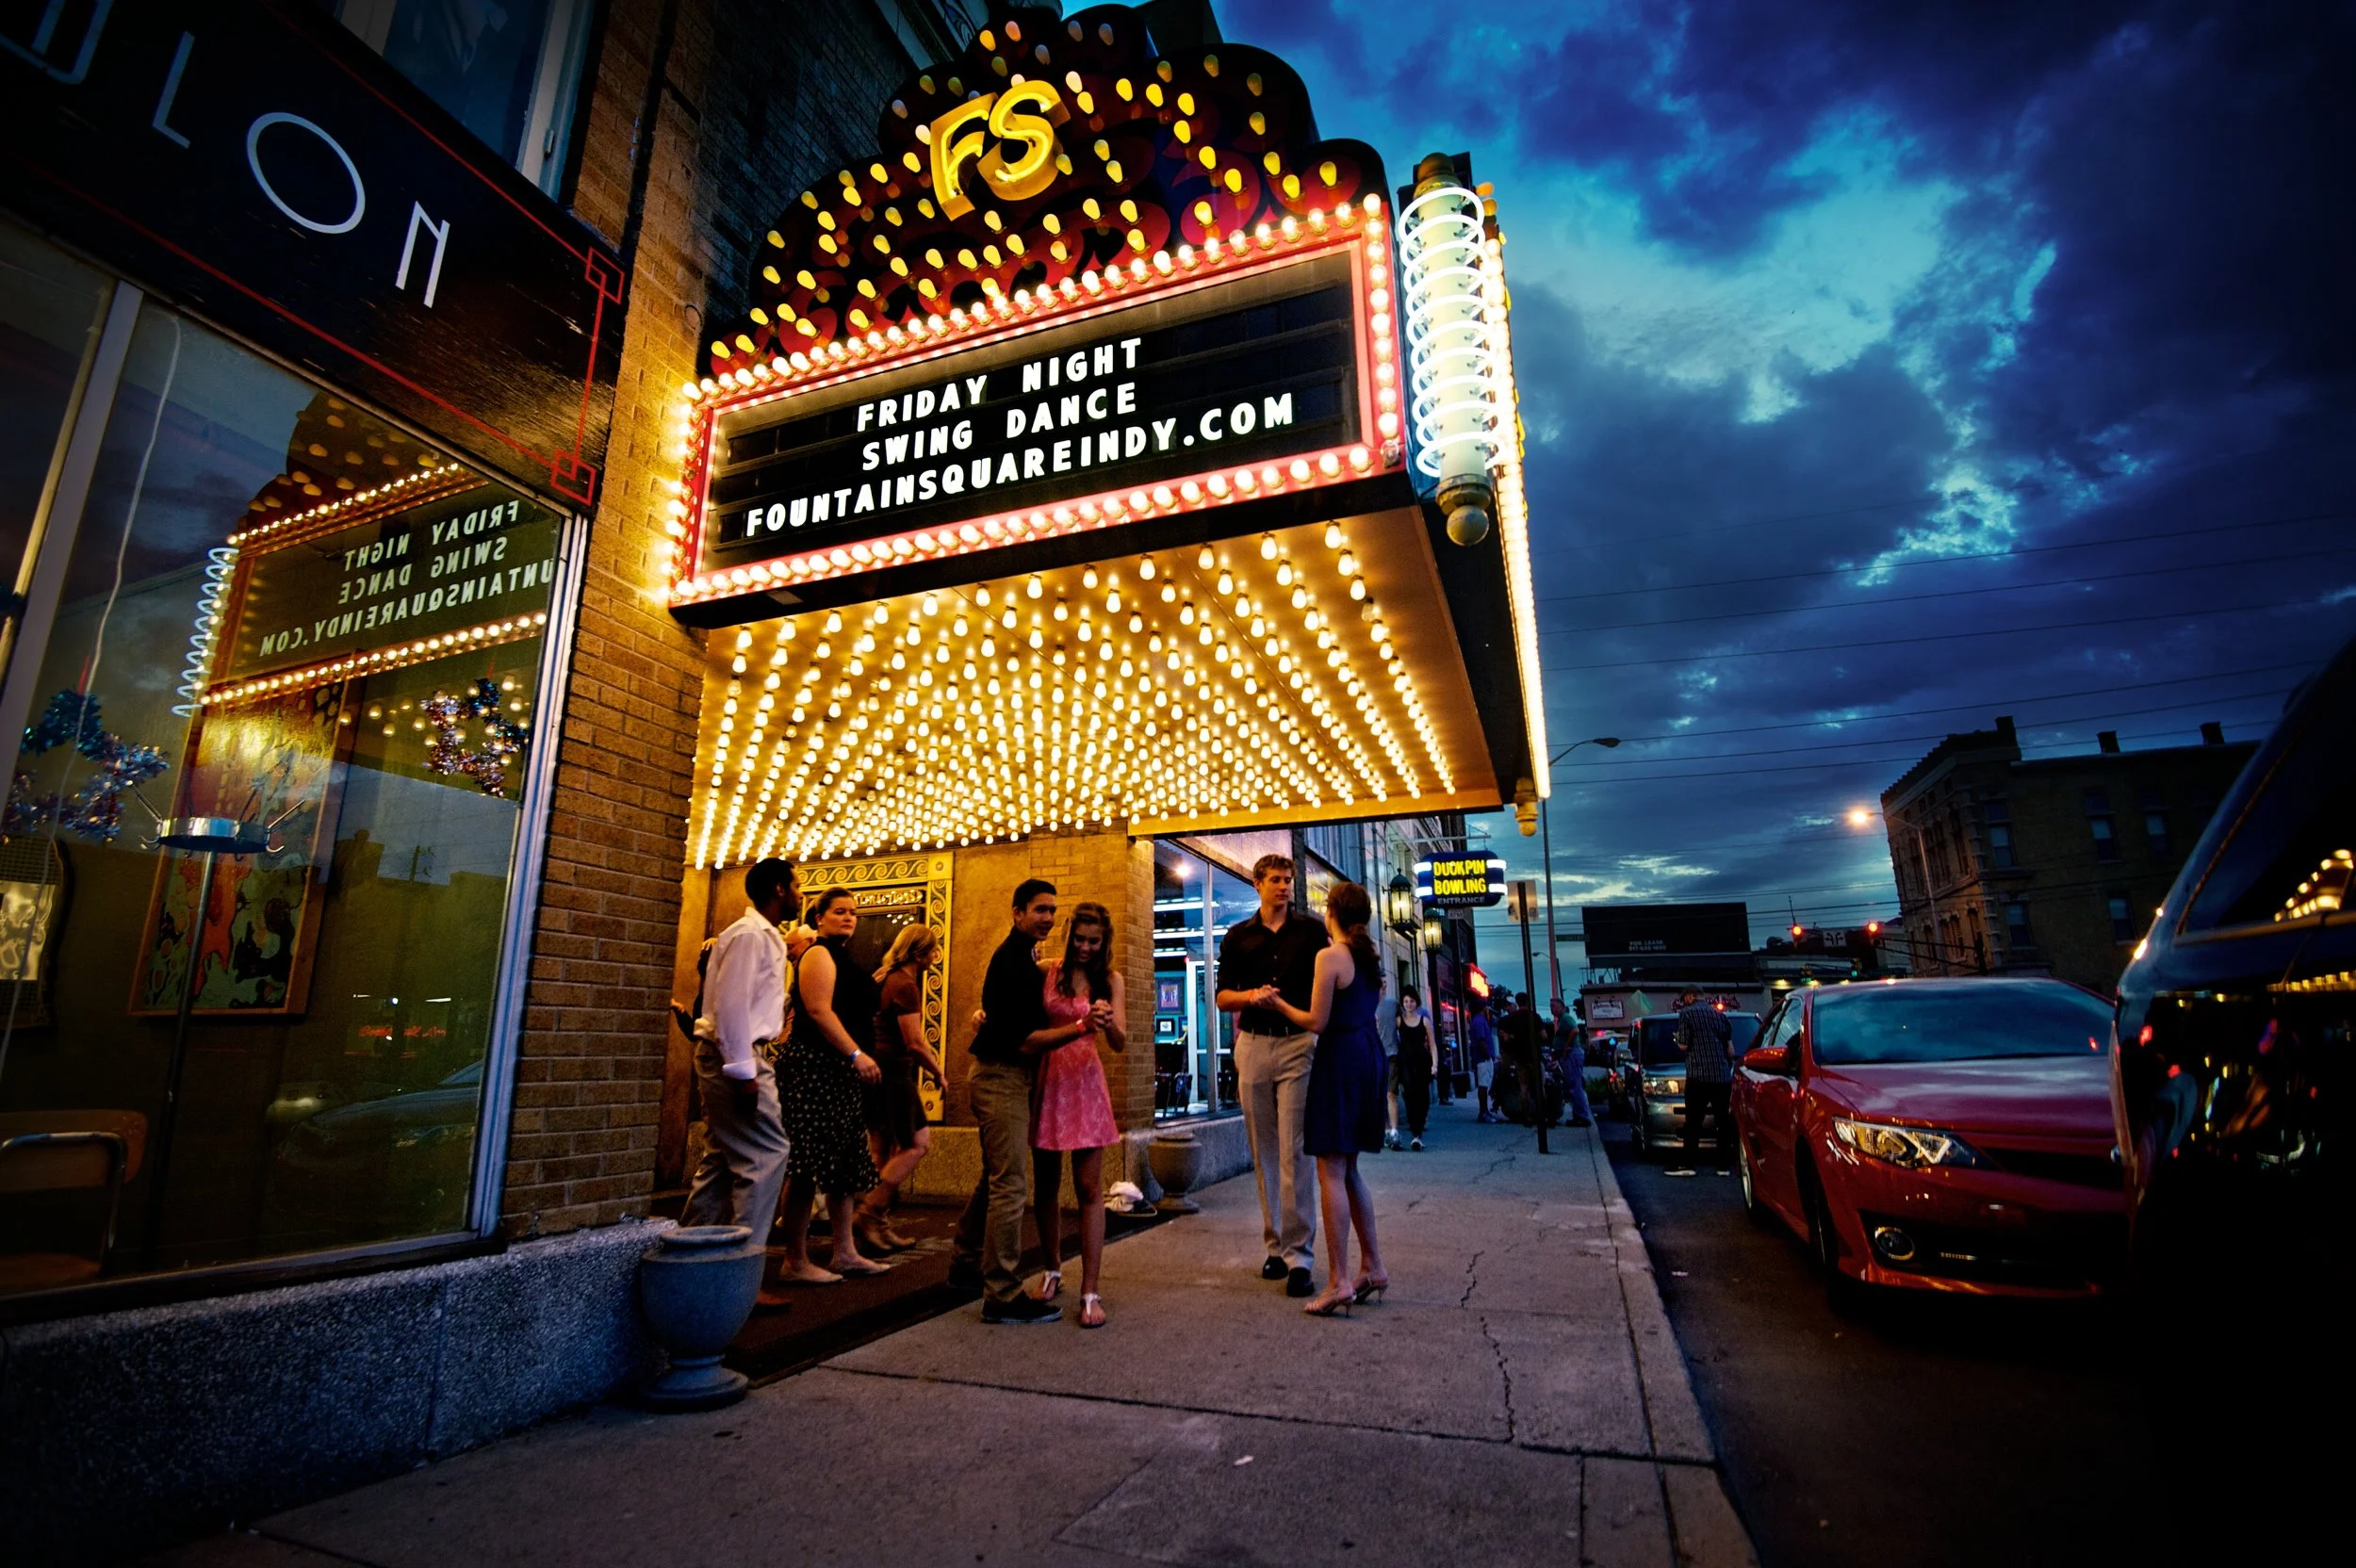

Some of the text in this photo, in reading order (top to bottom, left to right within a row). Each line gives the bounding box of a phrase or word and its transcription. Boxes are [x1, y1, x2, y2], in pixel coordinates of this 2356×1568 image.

[929, 79, 1072, 221] FS
[857, 337, 1141, 433] FRIDAY NIGHT
[861, 382, 1137, 471] SWING DANCE
[745, 392, 1294, 537] FOUNTAINSQUAREINDY.COM
[1433, 877, 1486, 896] BOWLING
[1437, 896, 1485, 905] ENTRANCE
